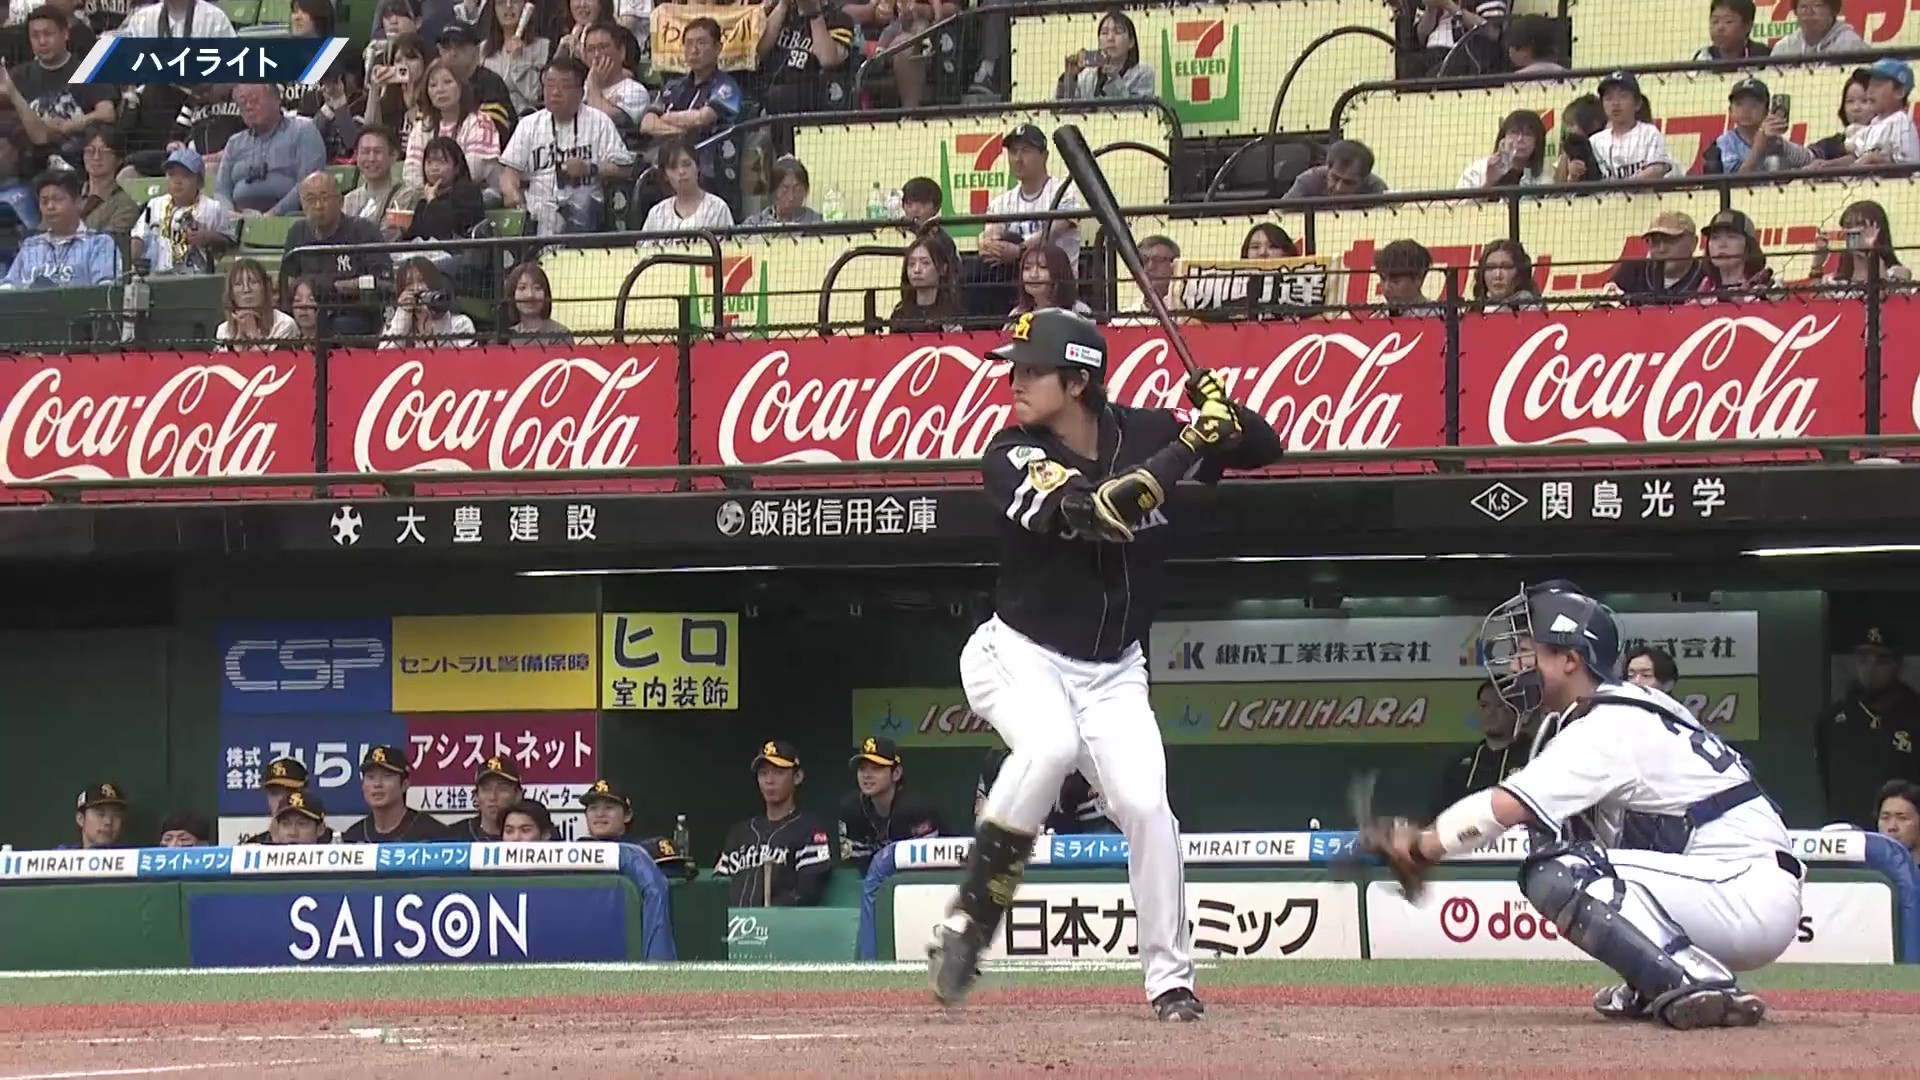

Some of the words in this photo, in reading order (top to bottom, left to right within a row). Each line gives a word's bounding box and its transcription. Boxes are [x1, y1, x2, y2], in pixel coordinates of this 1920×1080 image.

[788, 50, 808, 69] 38
[1488, 313, 1842, 446] Coca-Cola
[0, 364, 296, 482] Coca-Cola
[354, 356, 660, 471] Coca-Cola
[750, 496, 938, 536] 飯能信用金庫
[1542, 478, 1726, 521] 関島光学
[396, 504, 597, 544] 大豊建設
[613, 616, 727, 669] ヒロ
[225, 637, 386, 692] CSP
[400, 653, 590, 674] セントラル警備保障
[611, 675, 729, 709] 室内装飾
[1216, 697, 1428, 731] ICHIHARA
[410, 730, 592, 769] アシストネット
[26, 856, 84, 872] MIRAIT
[89, 855, 126, 872] ONE
[140, 853, 230, 871] ミライト・ワン
[265, 850, 325, 867] MIRAIT
[328, 849, 364, 866] ONE
[378, 847, 468, 866] ミライト・ワン
[505, 848, 564, 864] MIRAIT
[567, 848, 605, 864] ONE
[1188, 839, 1251, 856] MIRAIT
[1255, 839, 1295, 856] ONE
[1803, 837, 1847, 854] ONE
[288, 892, 528, 960] SAISON
[1006, 897, 1319, 957] 日本カミック
